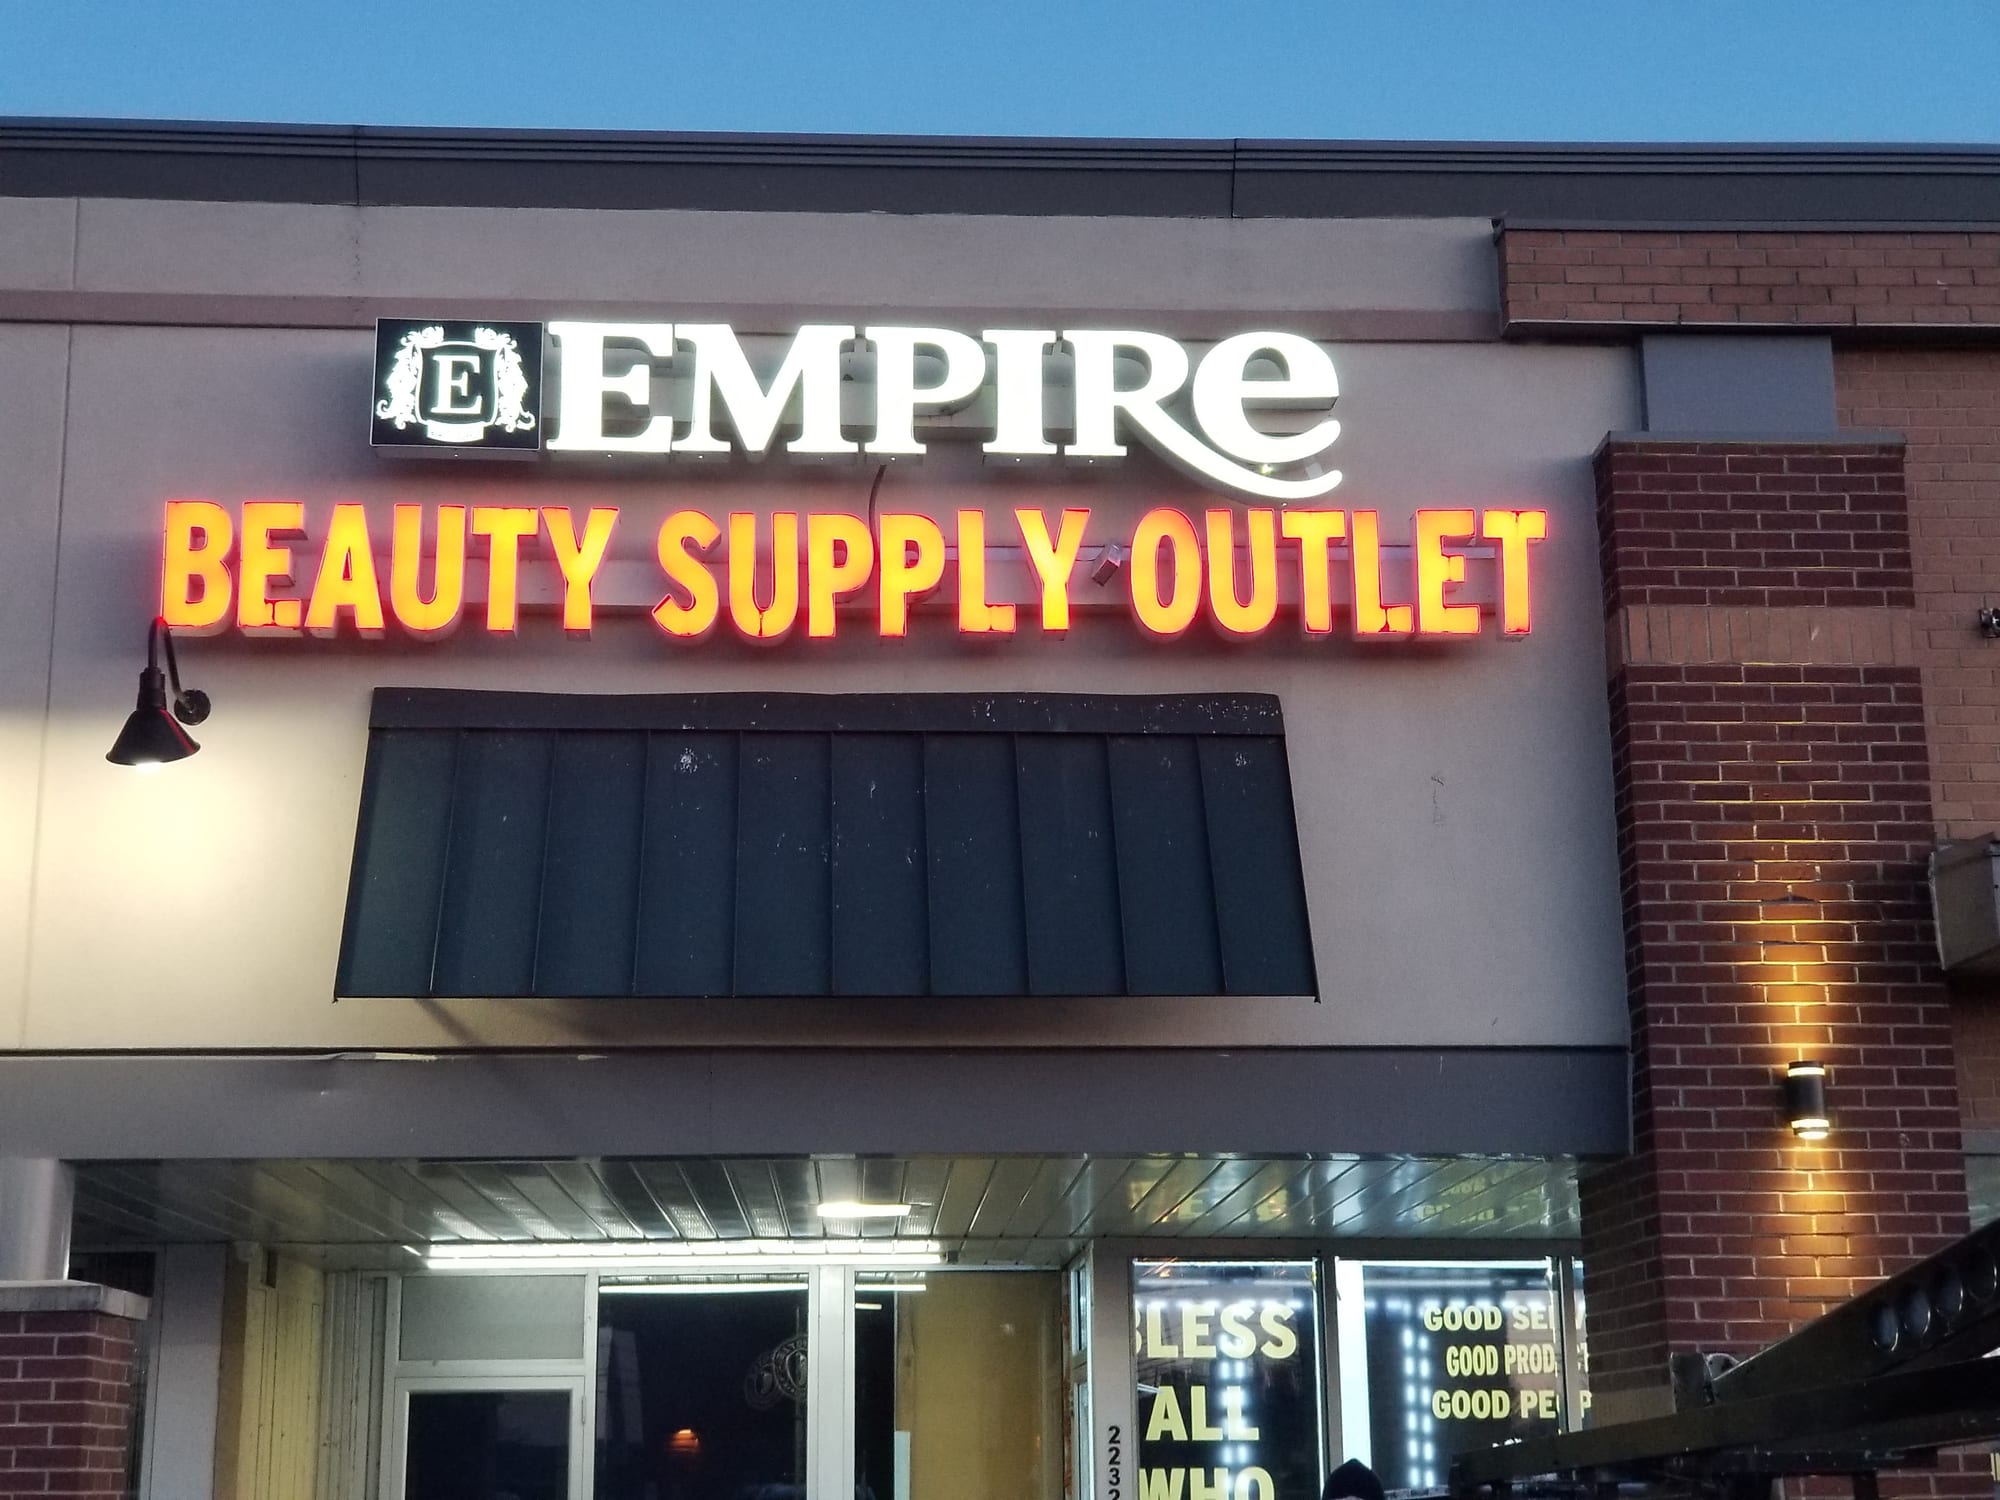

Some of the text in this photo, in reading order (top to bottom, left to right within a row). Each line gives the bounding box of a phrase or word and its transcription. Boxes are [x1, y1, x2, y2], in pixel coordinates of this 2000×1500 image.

[432, 354, 484, 416] E
[161, 501, 1547, 638] BEAUTY SUPPLY OUTLET
[1136, 1302, 1297, 1359] LESS
[1424, 1305, 1503, 1331] GOOD
[1446, 1345, 1499, 1377] GOOD
[1145, 1386, 1260, 1441] ALL
[1432, 1390, 1511, 1419] GOOD
[1138, 1466, 1275, 1500] WHO
